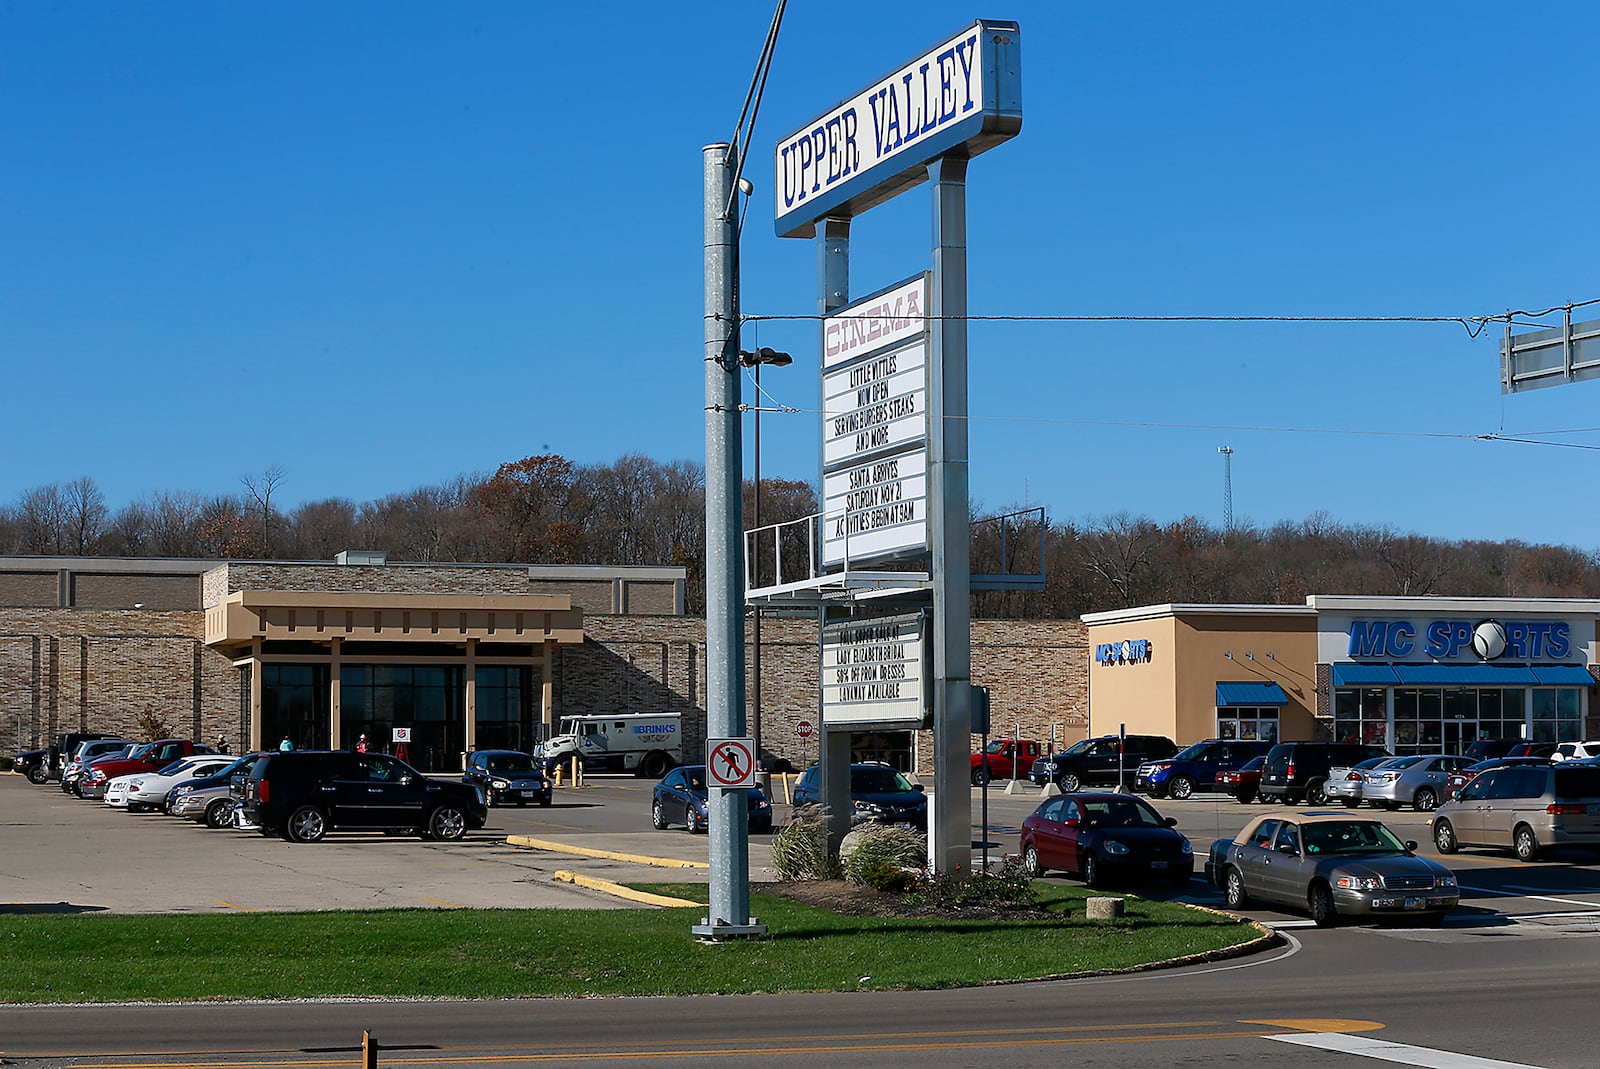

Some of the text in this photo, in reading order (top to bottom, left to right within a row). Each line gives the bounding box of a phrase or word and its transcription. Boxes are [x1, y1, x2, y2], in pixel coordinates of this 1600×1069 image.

[781, 35, 977, 208] UPPER VALLEY
[826, 290, 922, 357] CINEMA
[850, 355, 897, 388] LITTLE VITTLES
[857, 379, 889, 407] NOW OPEN
[834, 394, 914, 437] SERVING BURGERS STEAKS
[856, 425, 889, 452] AND MORE
[849, 460, 898, 490] SANTA ARRIVES
[846, 481, 902, 512] SATURDAY NOV 21
[835, 501, 914, 537] ACIVITIES BEGIN AT 9AM
[1096, 643, 1113, 662] MC
[1348, 618, 1570, 661] MC SPORTS
[836, 649, 851, 664] LADY
[836, 664, 906, 683] 50% OFF PROM DRESSES
[839, 683, 900, 702] LAYAWAY AVAILABLE
[639, 724, 676, 734] BRINKS
[797, 725, 812, 733] STOP
